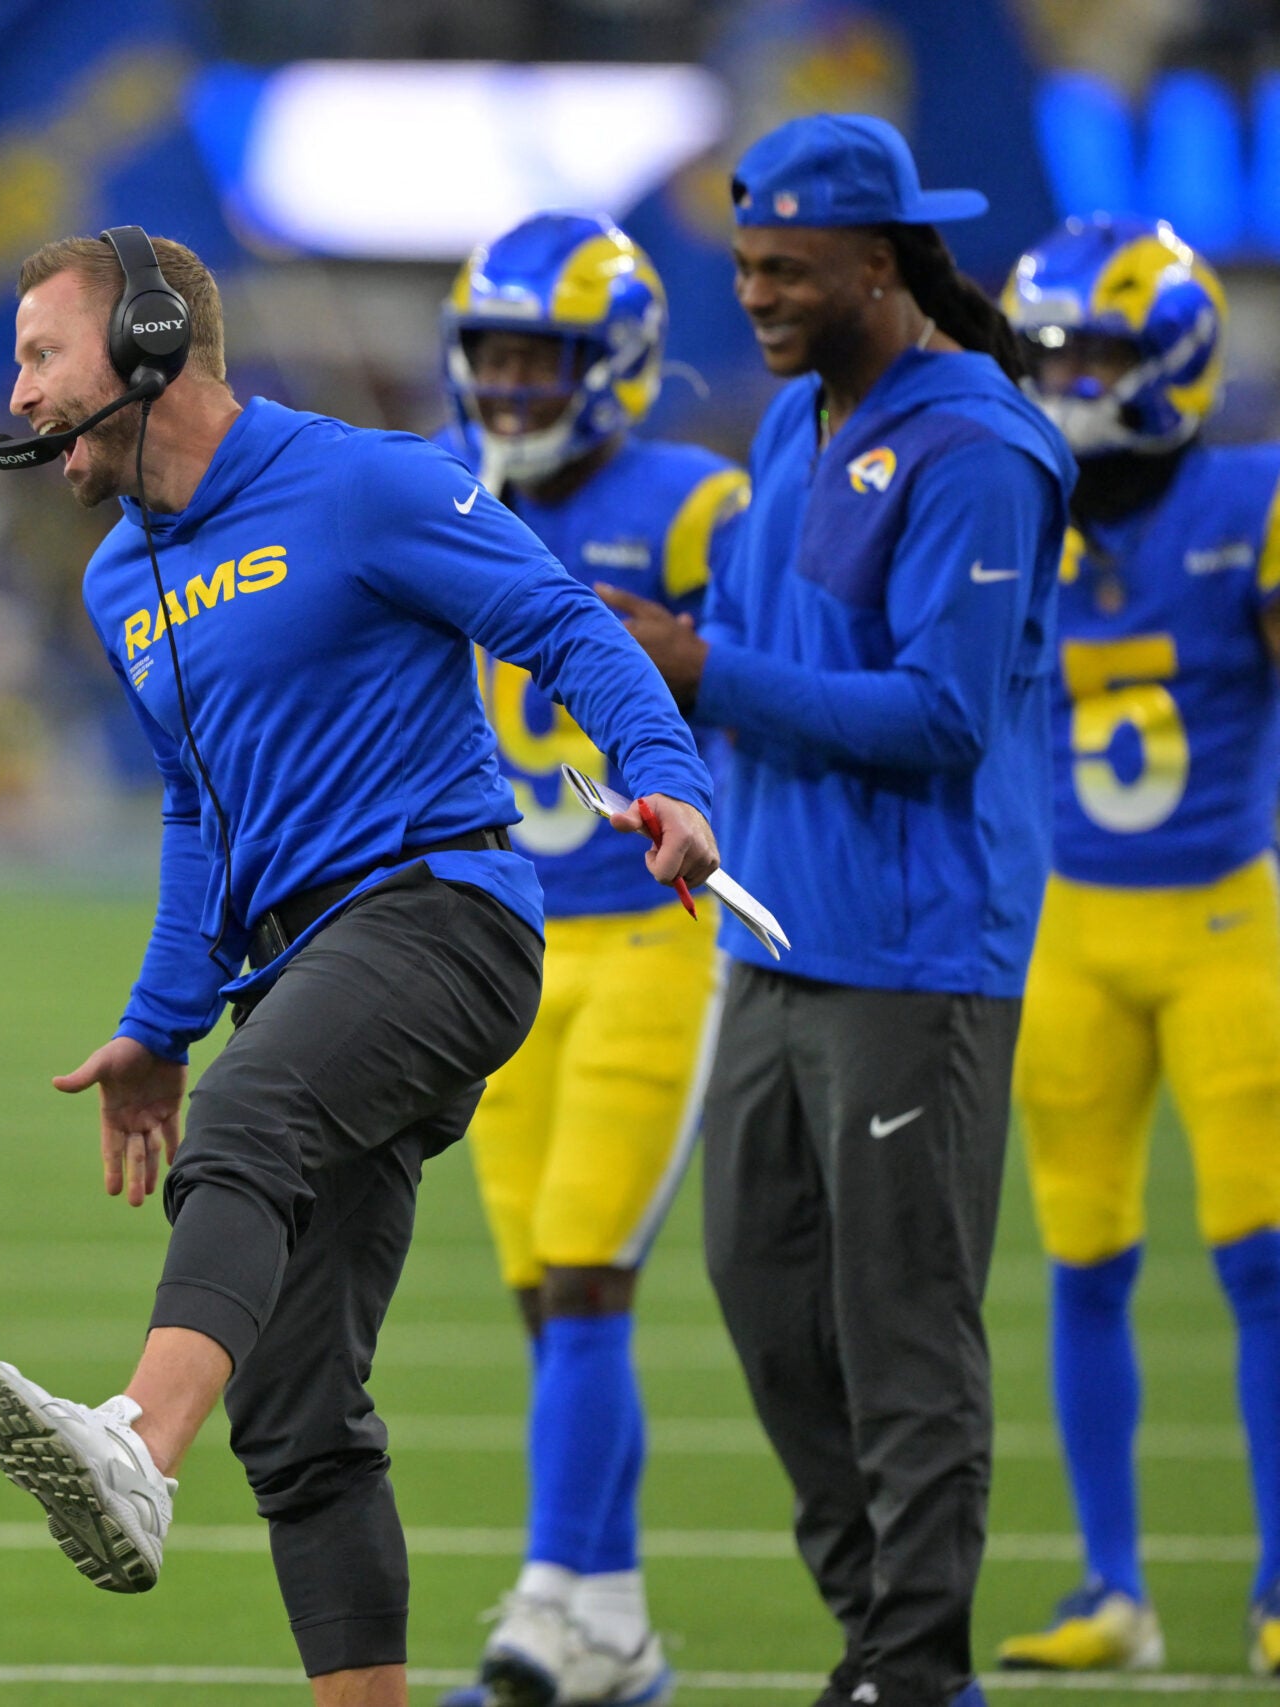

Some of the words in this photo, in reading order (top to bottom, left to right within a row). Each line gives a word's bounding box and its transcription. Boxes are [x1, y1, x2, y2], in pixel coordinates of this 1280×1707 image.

[132, 319, 185, 334] SONY
[124, 545, 288, 661] RAMS
[1060, 632, 1191, 834] 5
